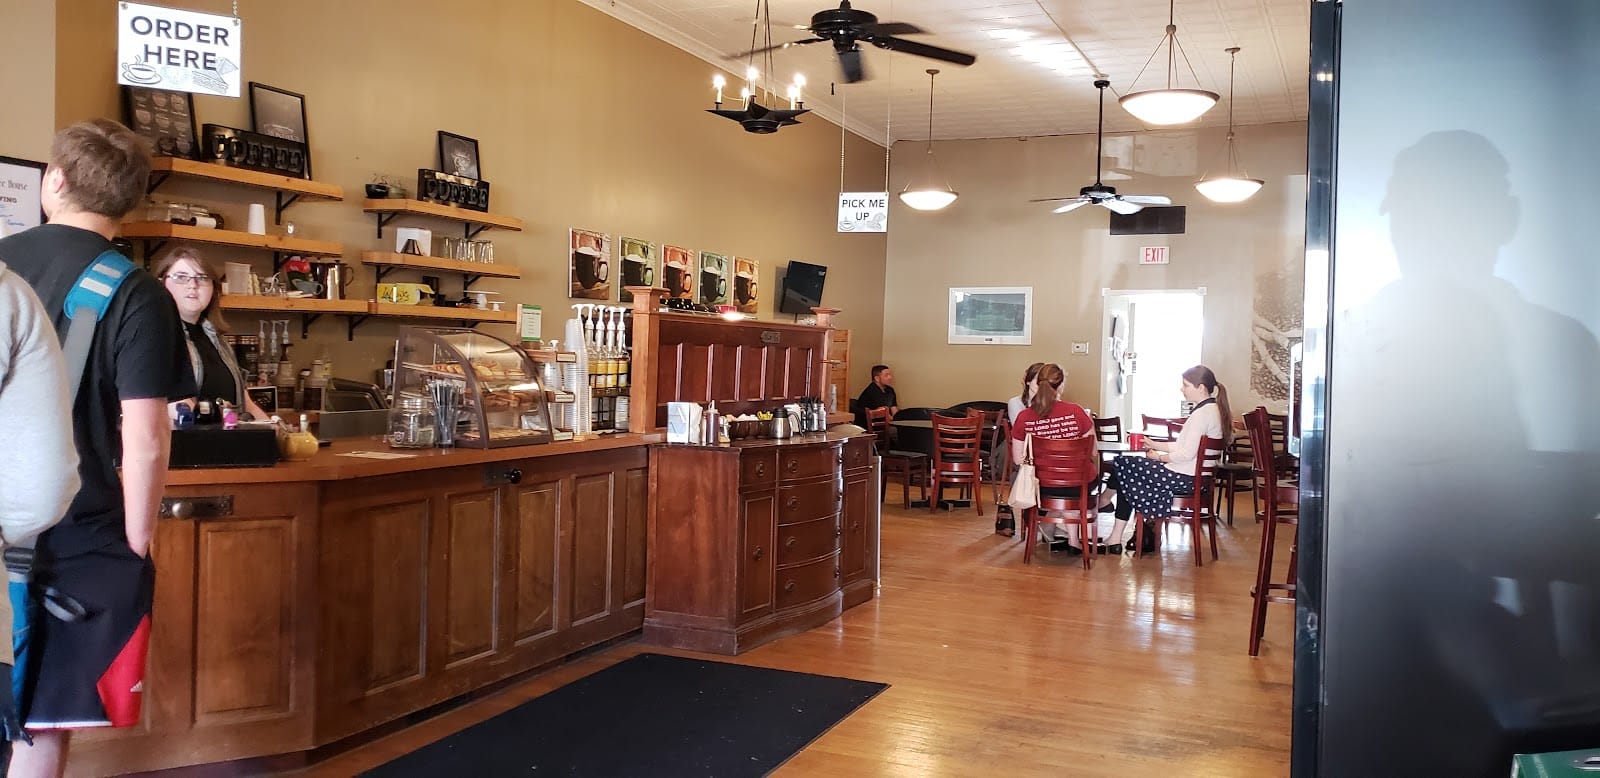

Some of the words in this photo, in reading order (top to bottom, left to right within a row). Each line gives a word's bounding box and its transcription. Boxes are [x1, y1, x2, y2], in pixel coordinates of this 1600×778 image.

[130, 15, 230, 47] ORDER
[143, 43, 217, 71] HERE
[212, 134, 303, 173] COFFEE
[427, 177, 488, 208] COFFEE
[842, 199, 866, 208] PICK
[868, 199, 885, 208] ME
[855, 212, 870, 221] UP
[1145, 247, 1166, 263] EXIT
